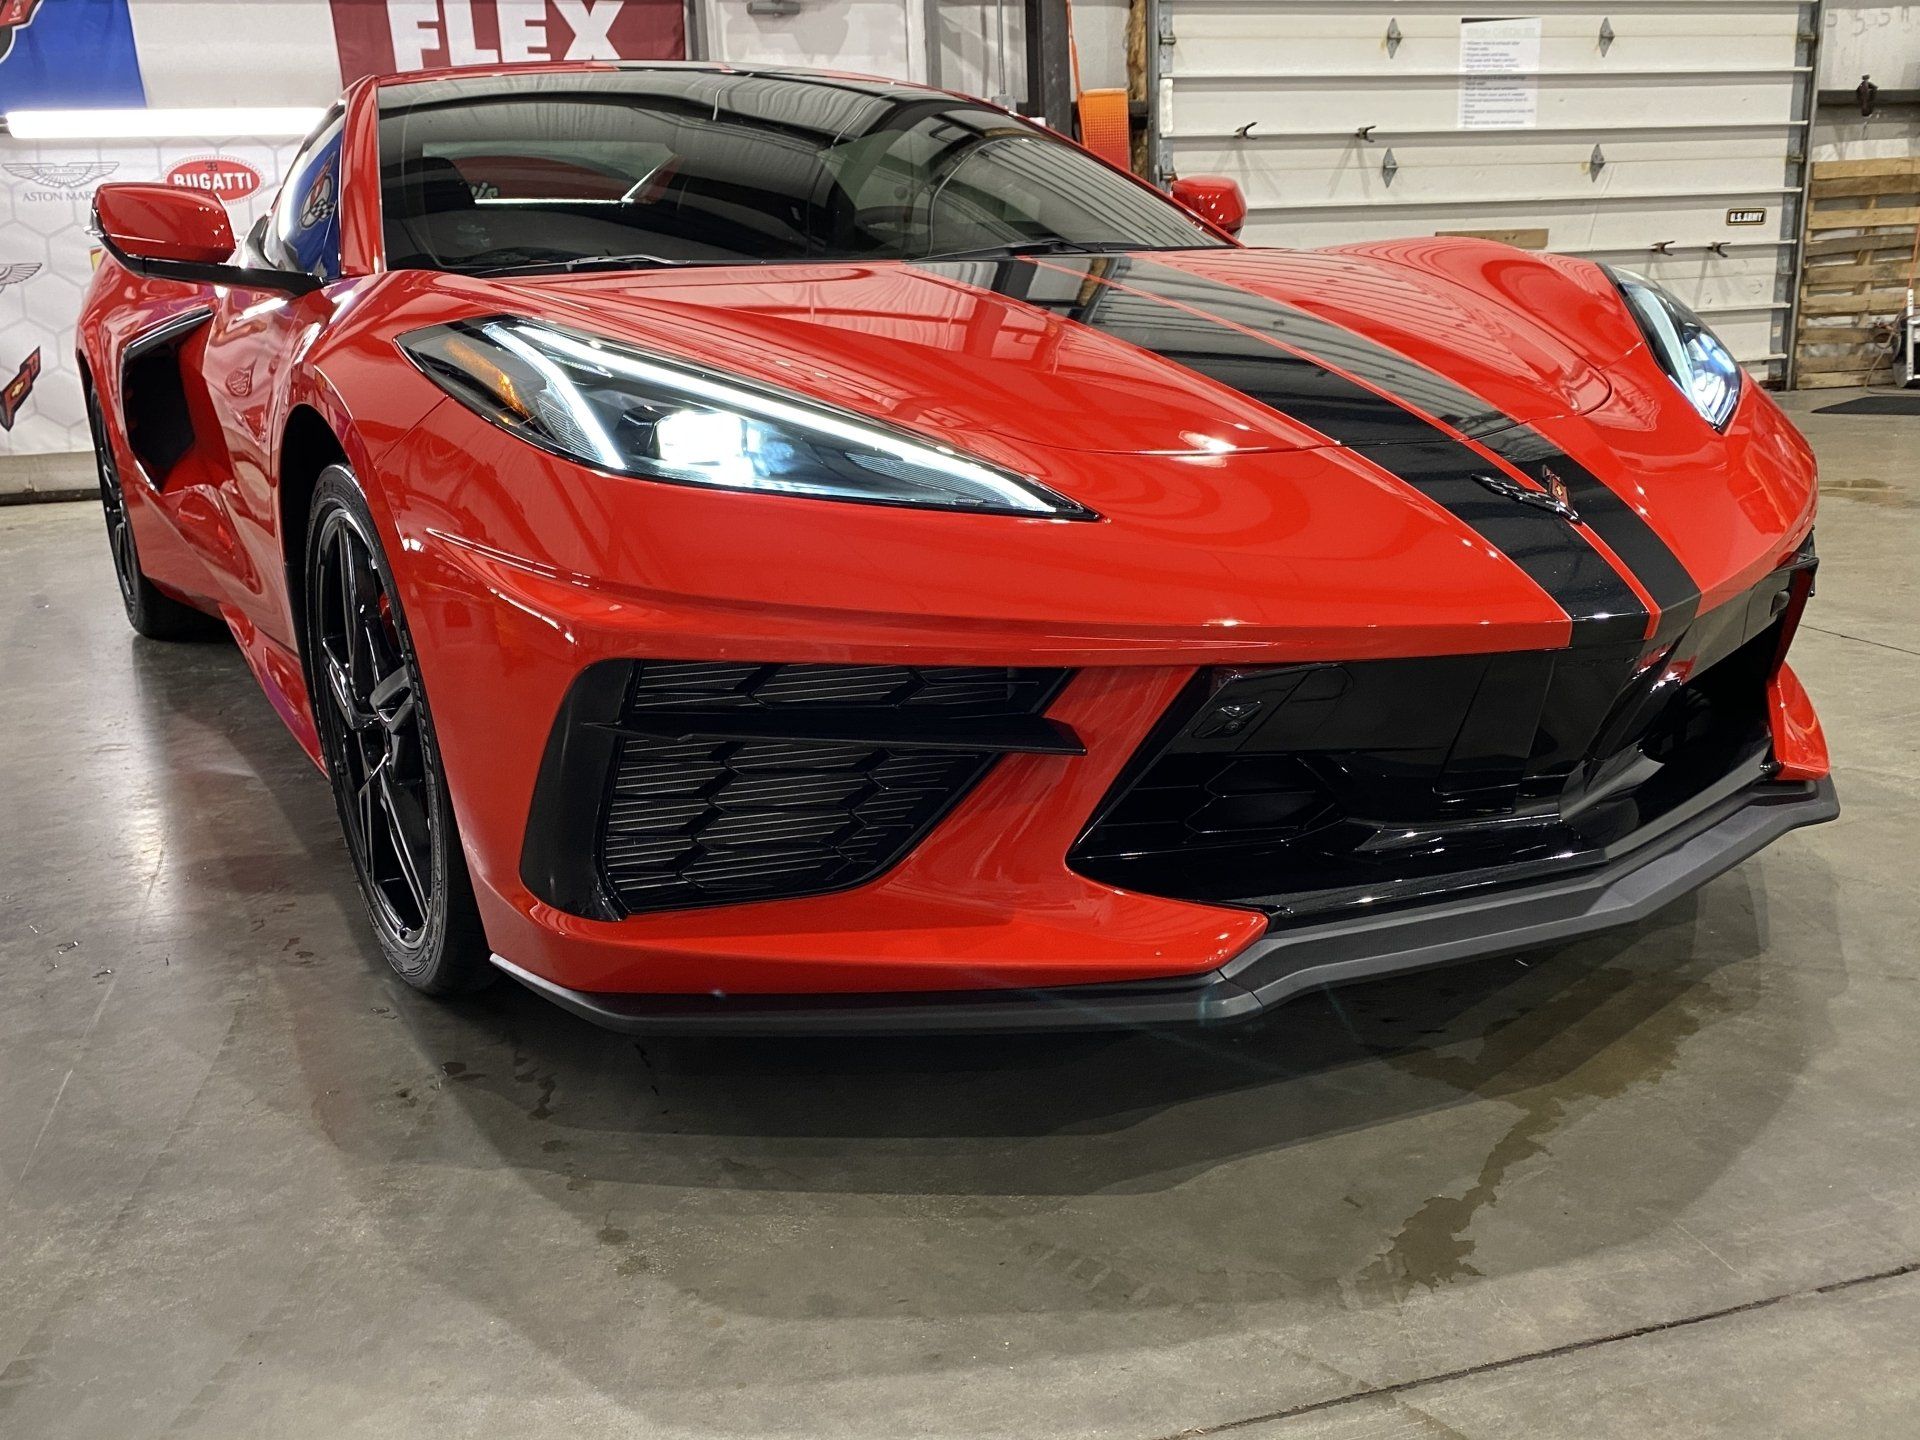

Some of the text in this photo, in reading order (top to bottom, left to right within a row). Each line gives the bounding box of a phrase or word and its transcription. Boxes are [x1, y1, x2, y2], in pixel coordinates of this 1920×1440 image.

[386, 0, 624, 73] FLEX
[173, 172, 253, 190] BUGATTI
[23, 191, 92, 202] ASTON MAR
